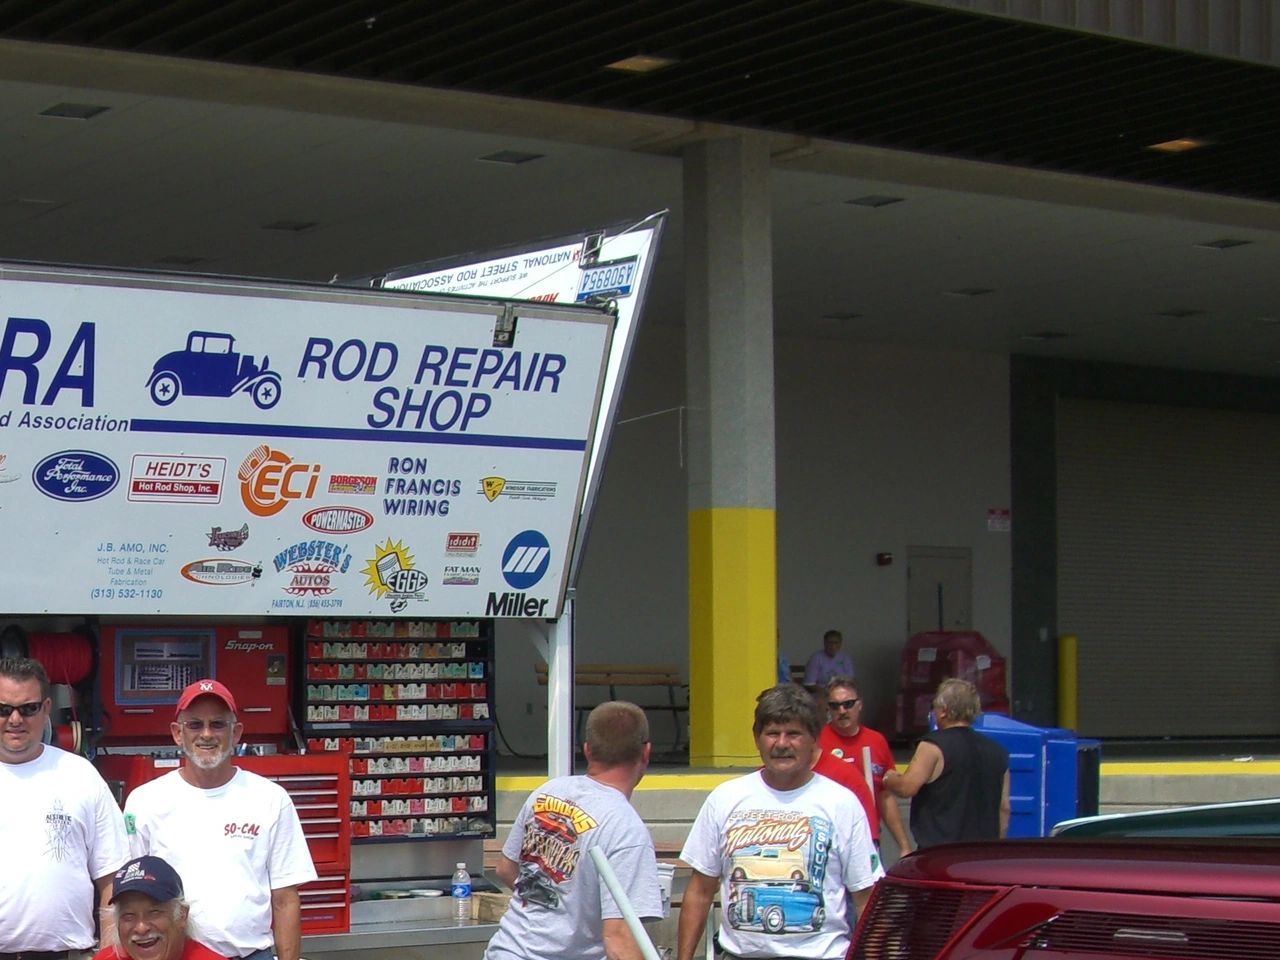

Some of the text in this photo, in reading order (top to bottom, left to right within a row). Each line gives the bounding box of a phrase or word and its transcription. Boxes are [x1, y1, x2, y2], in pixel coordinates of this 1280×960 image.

[480, 261, 518, 277] STREET
[523, 252, 570, 270] NATIONAL
[457, 269, 477, 281] ROD
[297, 337, 566, 393] ROD REPAIR
[367, 387, 491, 431] SHOP
[18, 411, 129, 432] Association
[55, 458, 83, 471] Total
[145, 462, 212, 478] HEIDT'S
[388, 457, 428, 475] RON
[44, 469, 112, 484] Performance
[138, 482, 213, 493] Hot Rod Shop, Inc.
[385, 478, 461, 497] FRANCIS
[384, 499, 450, 517] WIRING
[311, 511, 366, 531] POWERMASTER
[149, 544, 169, 553] INC.
[272, 540, 352, 574] WEBSTER'S
[134, 568, 153, 576] Metal
[110, 578, 147, 586] Fabrication
[290, 575, 330, 587] AUTOS
[387, 570, 428, 593] EGGE
[91, 589, 163, 599] (313) 532-1130
[485, 592, 548, 616] Miller
[224, 640, 274, 653] Snap-on
[224, 823, 260, 836] SO-CAL
